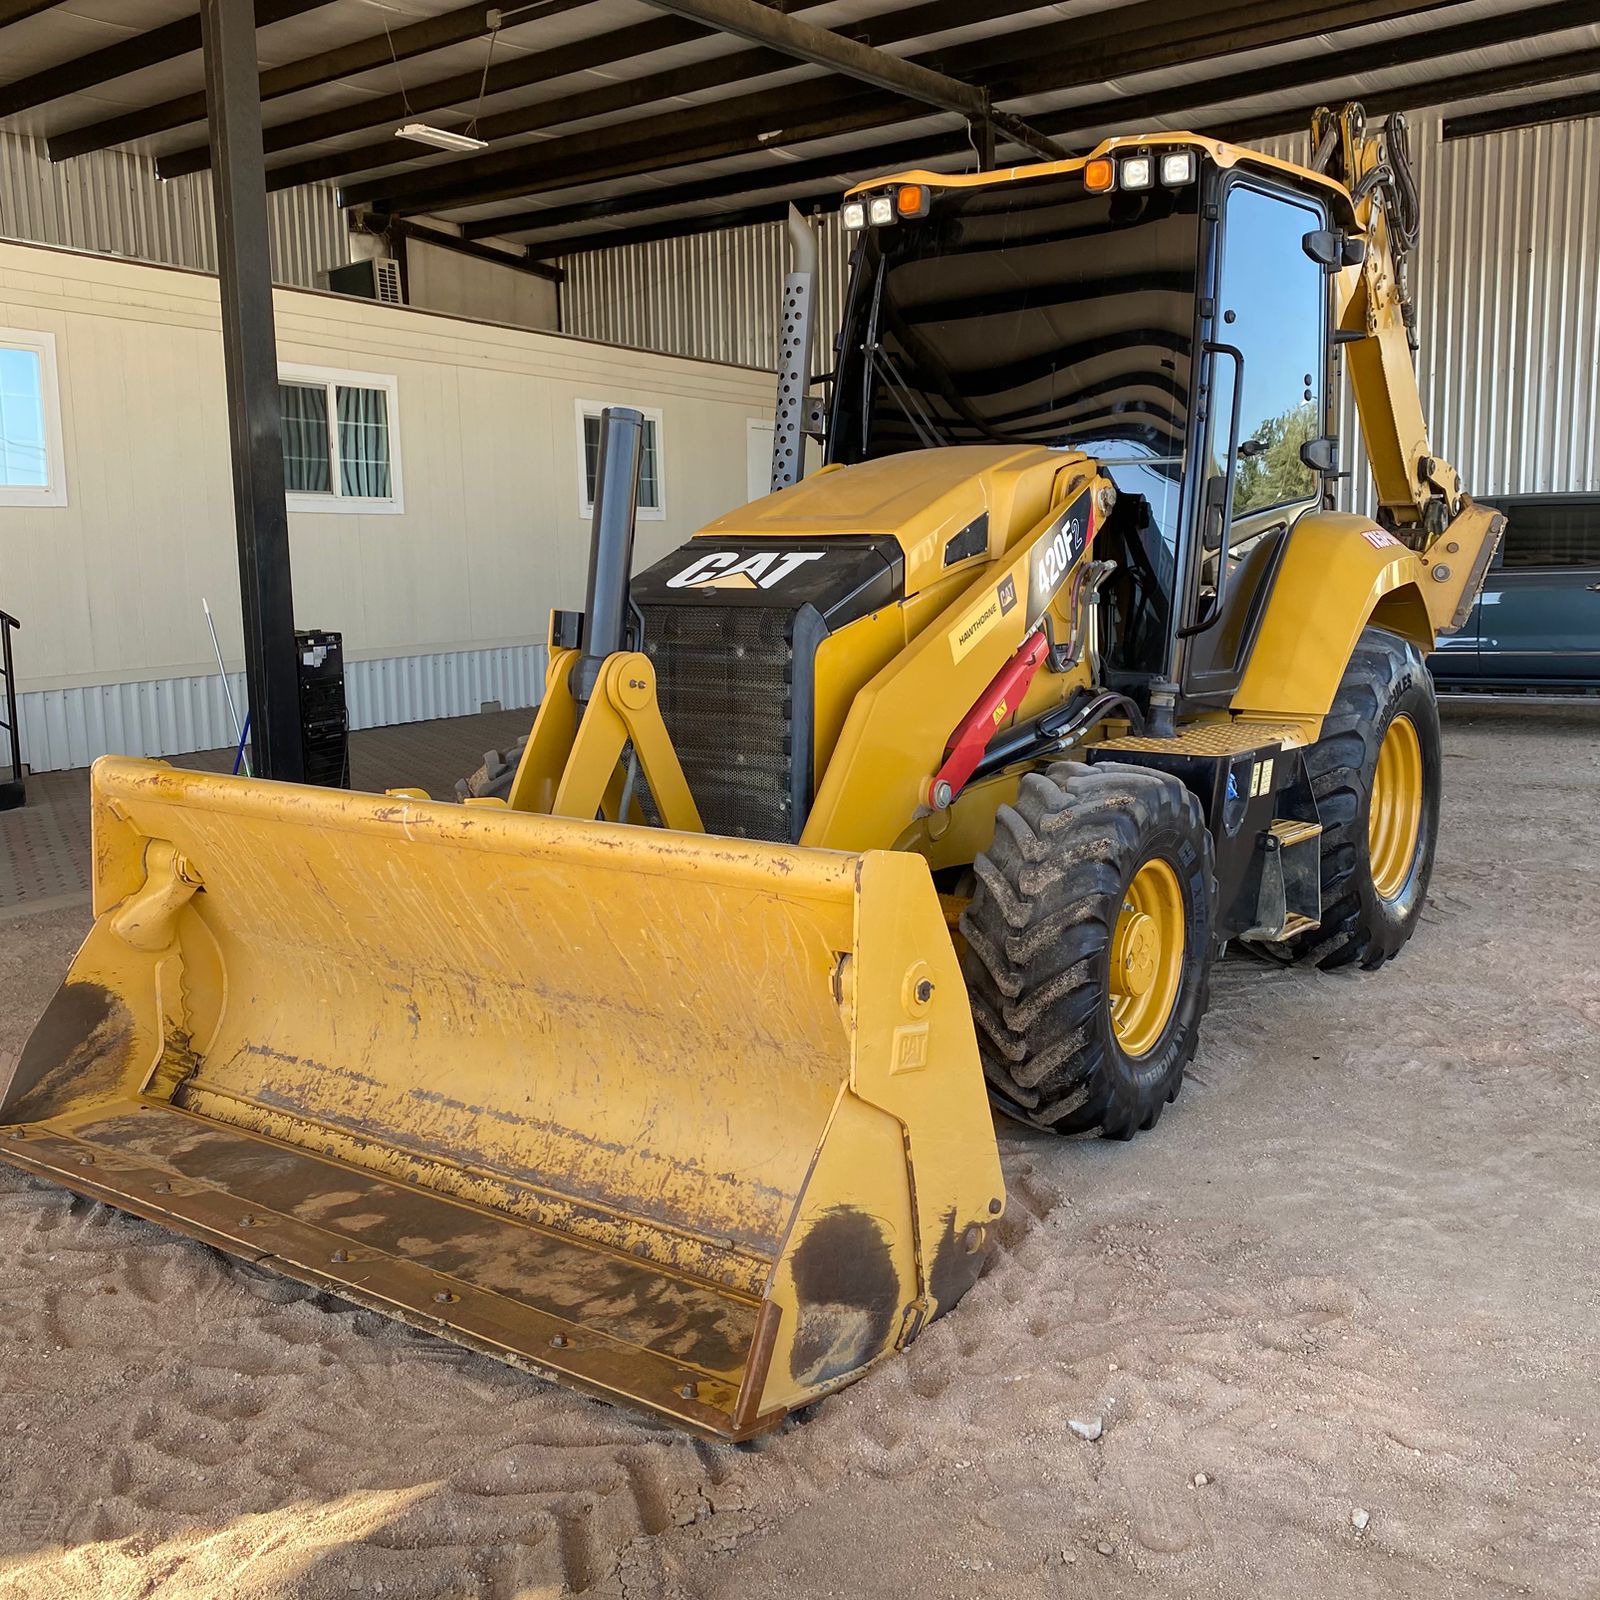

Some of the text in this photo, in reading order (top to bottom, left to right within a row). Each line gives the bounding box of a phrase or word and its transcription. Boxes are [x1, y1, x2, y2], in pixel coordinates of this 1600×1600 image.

[666, 552, 827, 589] CAT
[1000, 583, 1015, 607] CAT
[958, 603, 998, 646] HAWTHORNE
[899, 1035, 927, 1065] CAT
